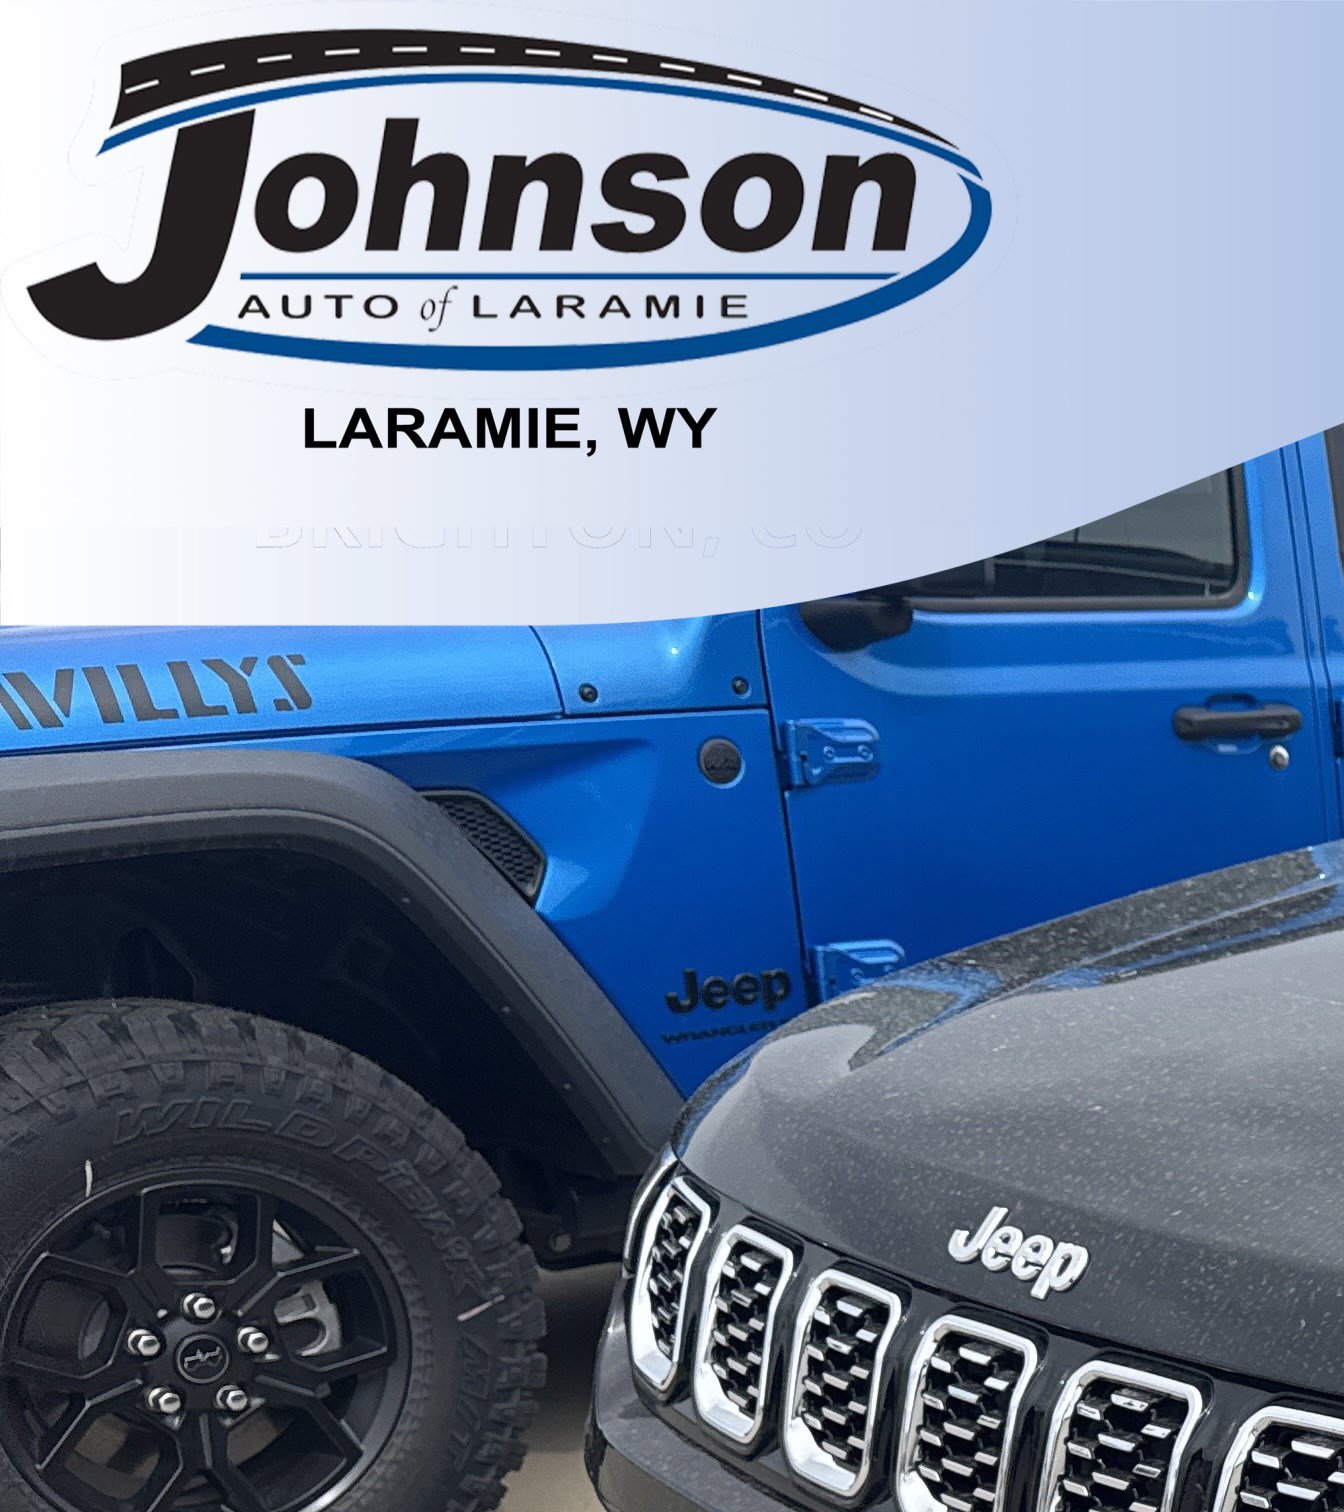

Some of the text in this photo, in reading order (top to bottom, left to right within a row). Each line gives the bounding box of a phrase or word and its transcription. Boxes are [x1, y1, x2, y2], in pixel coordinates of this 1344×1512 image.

[0, 654, 312, 730] WILLYS
[664, 969, 791, 1014] Jeep
[948, 1206, 1089, 1300] Jeep
